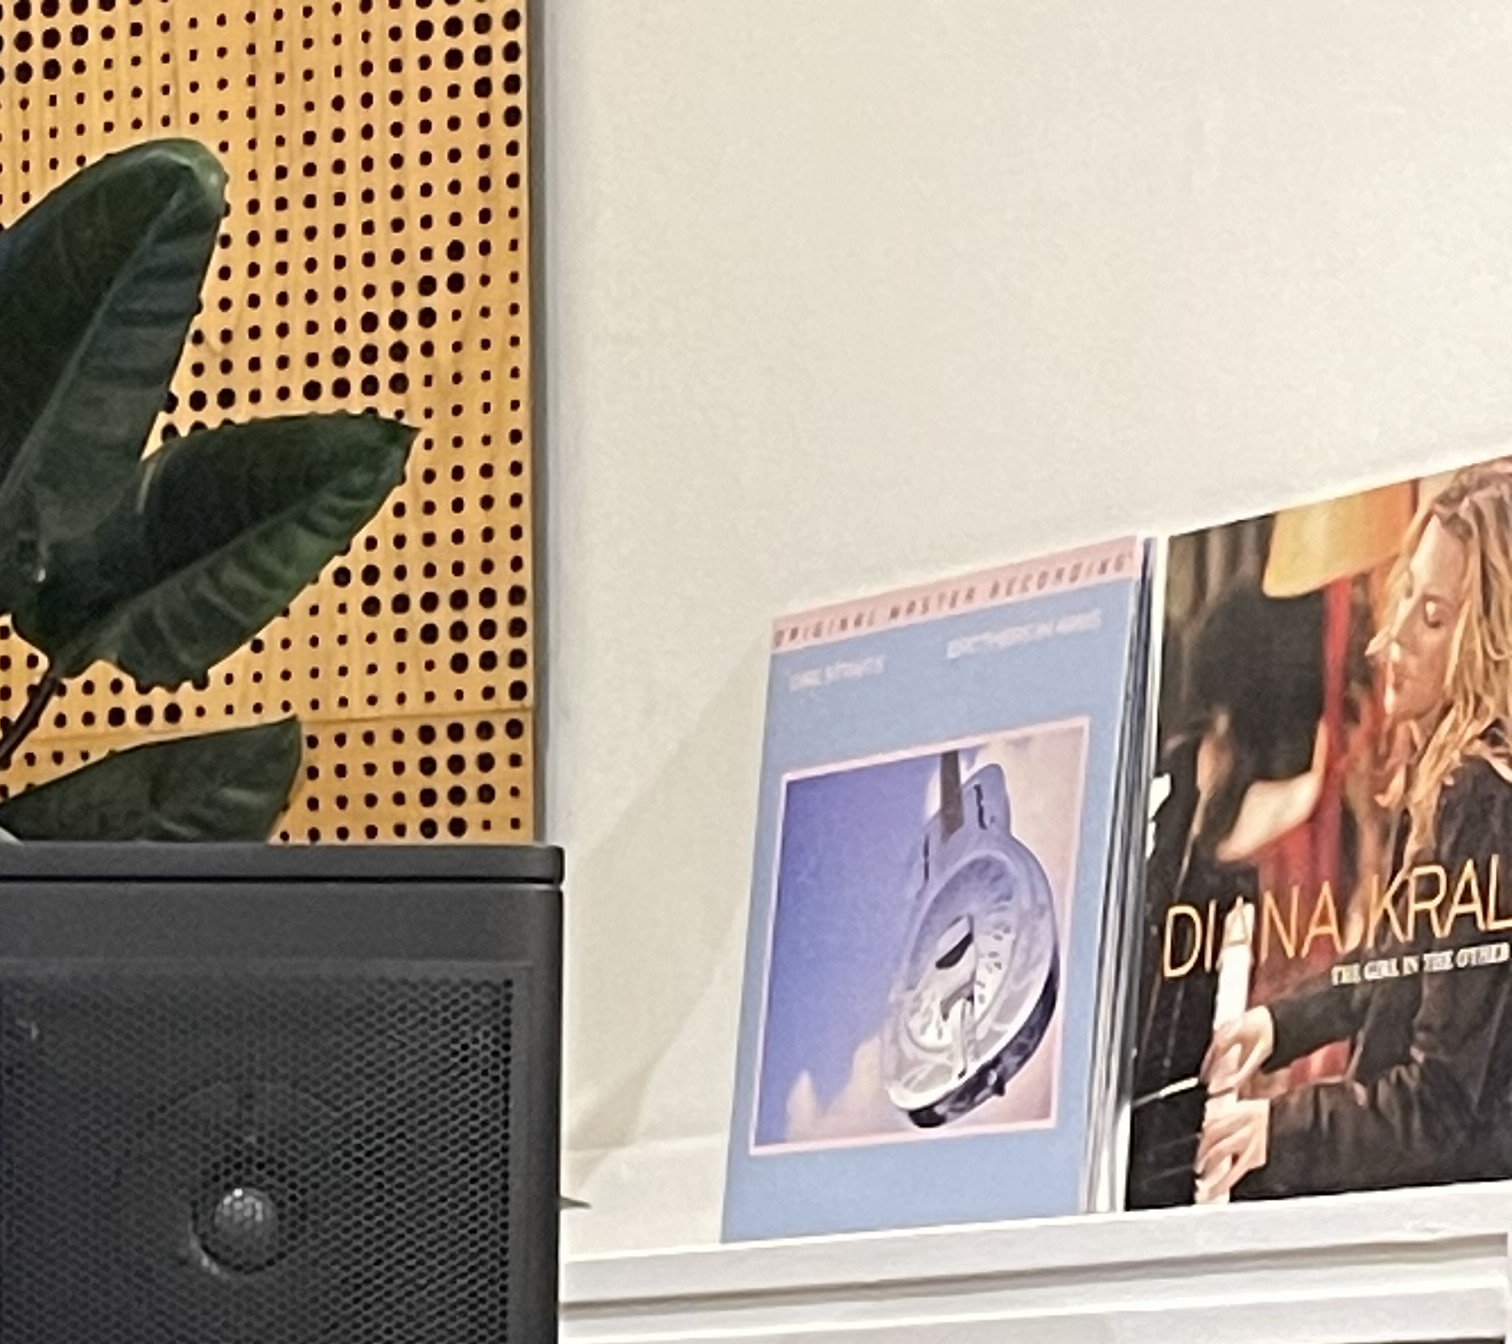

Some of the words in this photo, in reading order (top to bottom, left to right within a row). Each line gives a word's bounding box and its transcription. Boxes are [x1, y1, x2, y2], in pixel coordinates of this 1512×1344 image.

[773, 611, 876, 648] ORIGINAL
[889, 586, 976, 622] MASTER
[989, 554, 1126, 600] RECORDING
[1162, 880, 1345, 979] DIANA
[1332, 965, 1360, 986] THE
[1364, 957, 1400, 980] GIRL
[1402, 955, 1420, 976] IN
[1423, 950, 1454, 972] THE
[1456, 942, 1511, 968] OTHER
